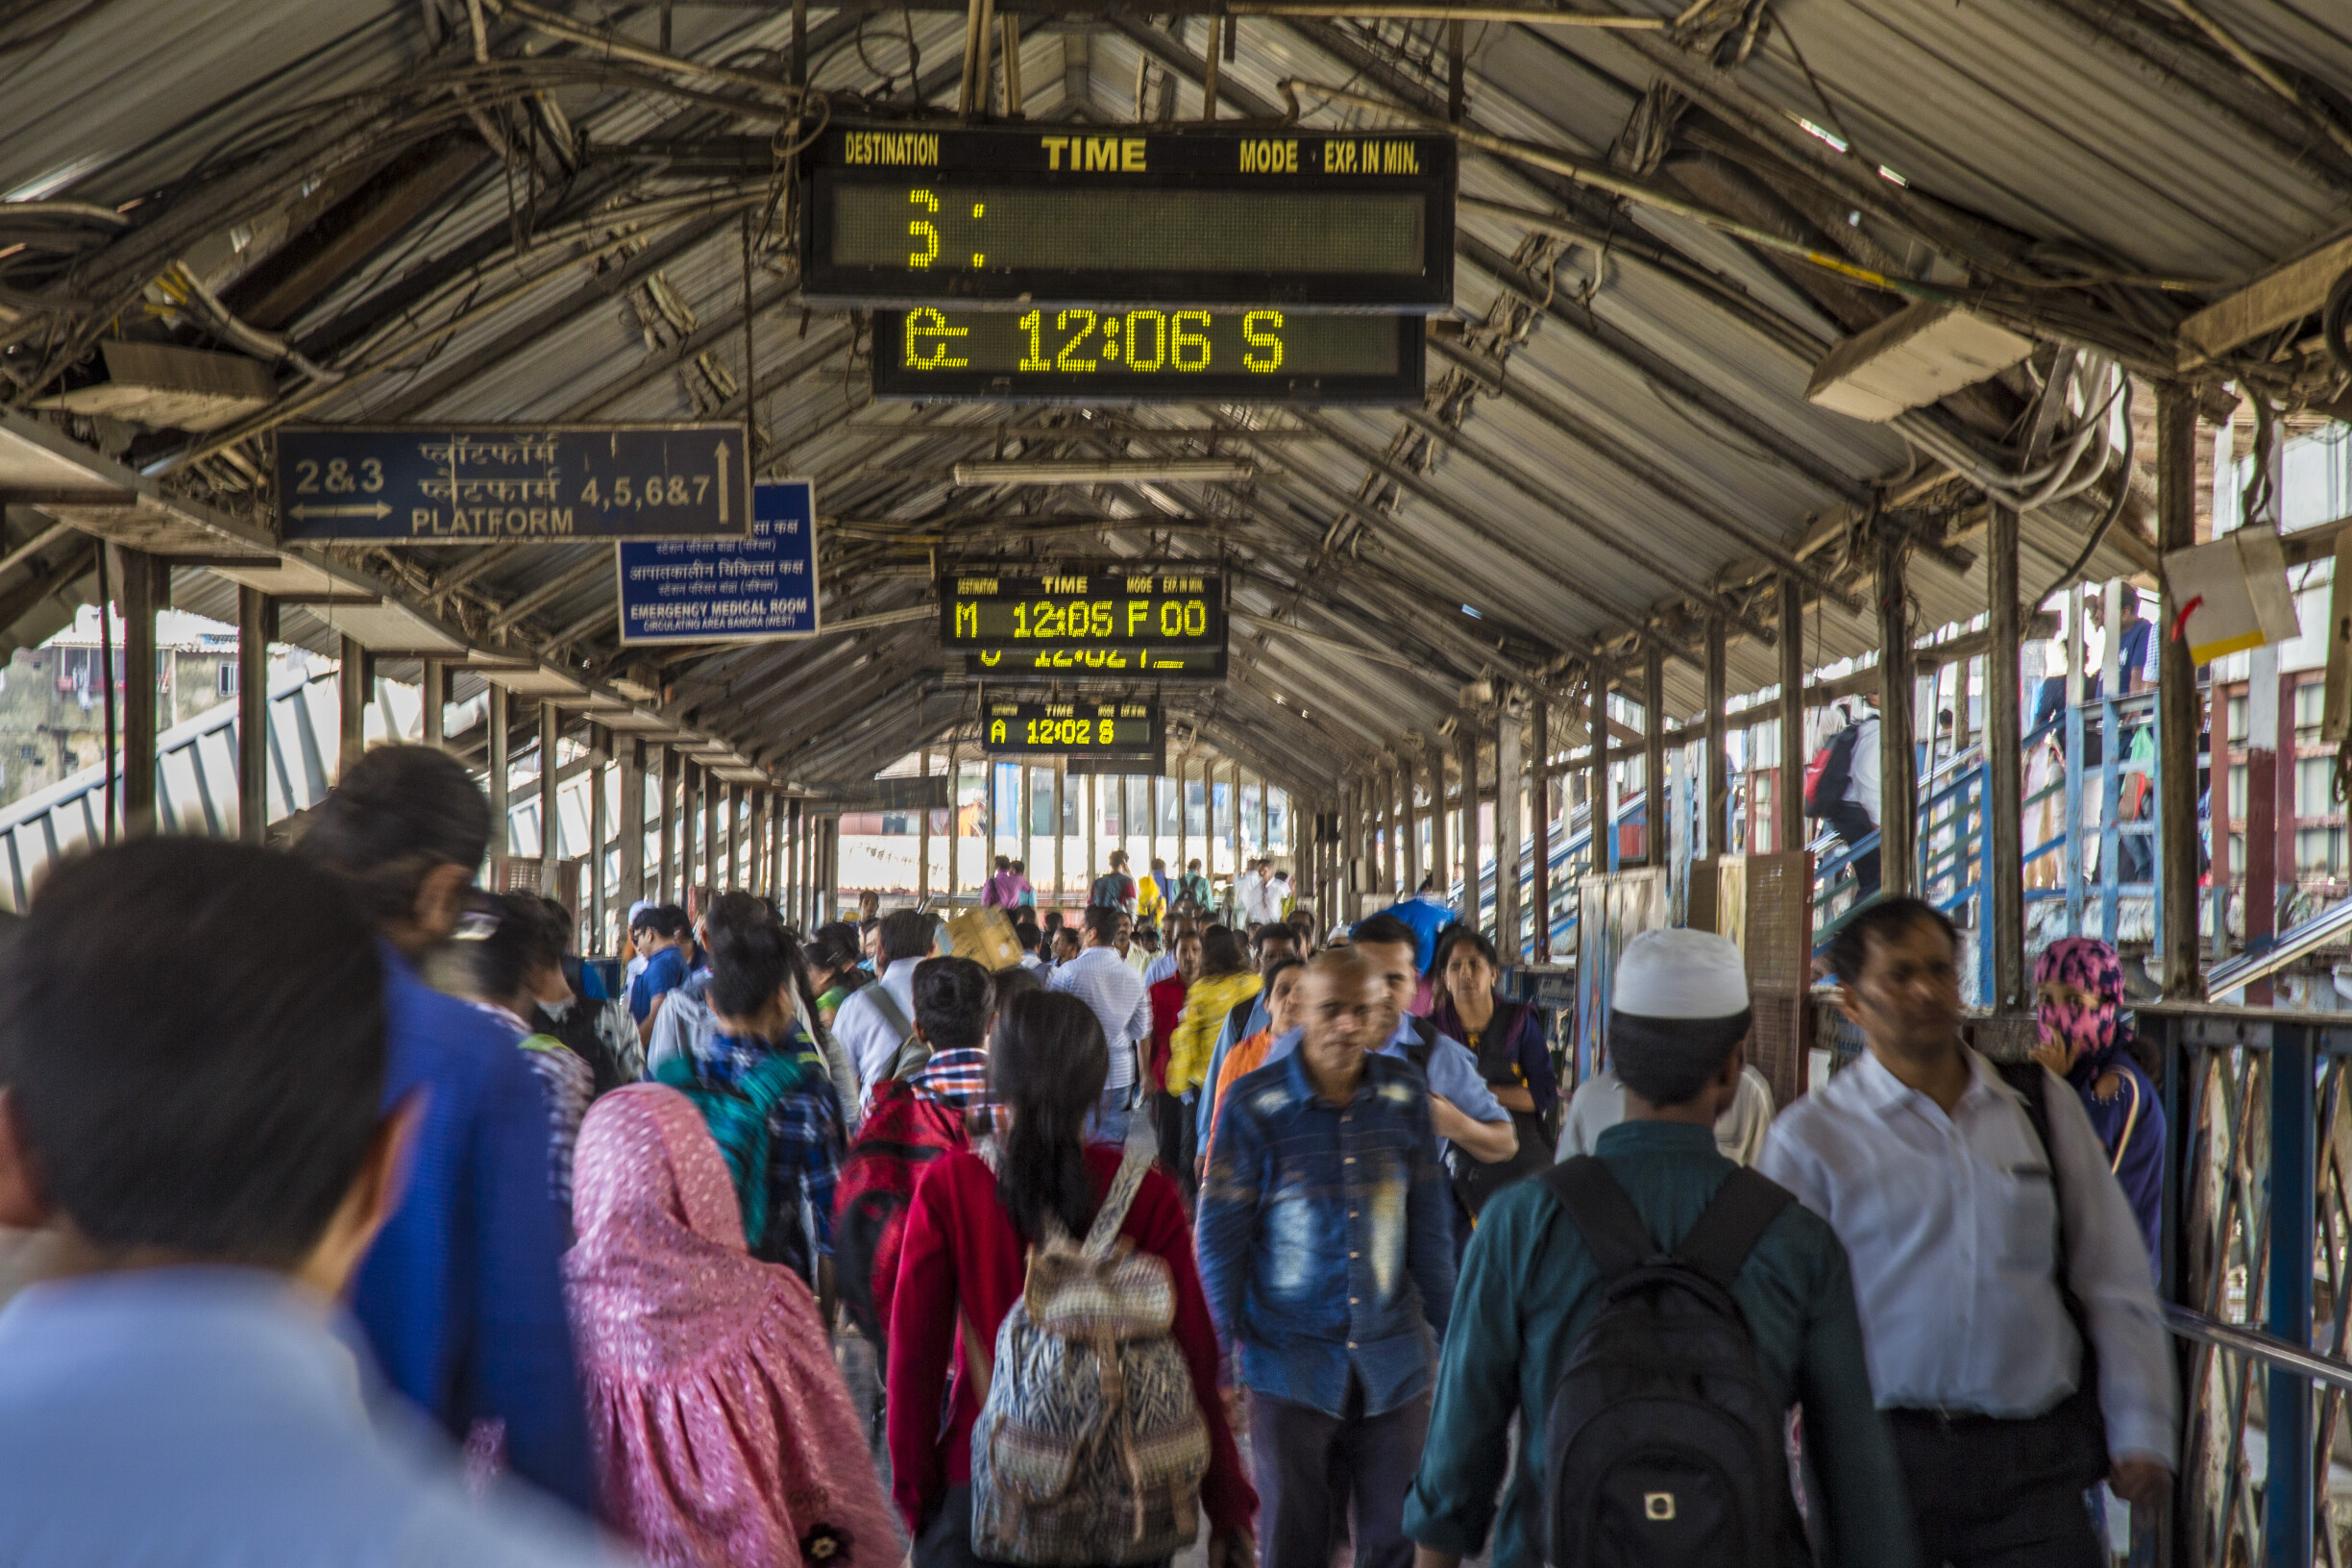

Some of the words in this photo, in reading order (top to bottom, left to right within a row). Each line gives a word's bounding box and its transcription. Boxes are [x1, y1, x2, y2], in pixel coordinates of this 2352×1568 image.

[845, 132, 939, 166] DESTINATION
[1041, 136, 1147, 172] TIME
[1240, 139, 1298, 173] MODE
[1324, 139, 1359, 174] EXP.
[1362, 139, 1380, 174] IN
[1384, 140, 1419, 175] MIN.
[1020, 308, 1211, 372] 12:06
[1243, 309, 1284, 373] S
[295, 457, 384, 494] 2&3
[411, 507, 575, 536] PLATFORM
[957, 578, 998, 595] DESTINATION
[1041, 576, 1088, 594] TIME
[1126, 576, 1153, 593] MODE
[630, 600, 708, 620] EMERGENCY
[711, 599, 767, 617] MEDICAL
[770, 597, 807, 614] ROOM
[955, 601, 978, 638] M
[1014, 600, 1114, 638] 12:05
[1128, 600, 1149, 637] F
[644, 618, 700, 632] CIRCULATING
[702, 616, 725, 629] AREA
[1044, 703, 1075, 718] TIME
[991, 719, 1006, 744] A
[1027, 719, 1090, 745] 12:02
